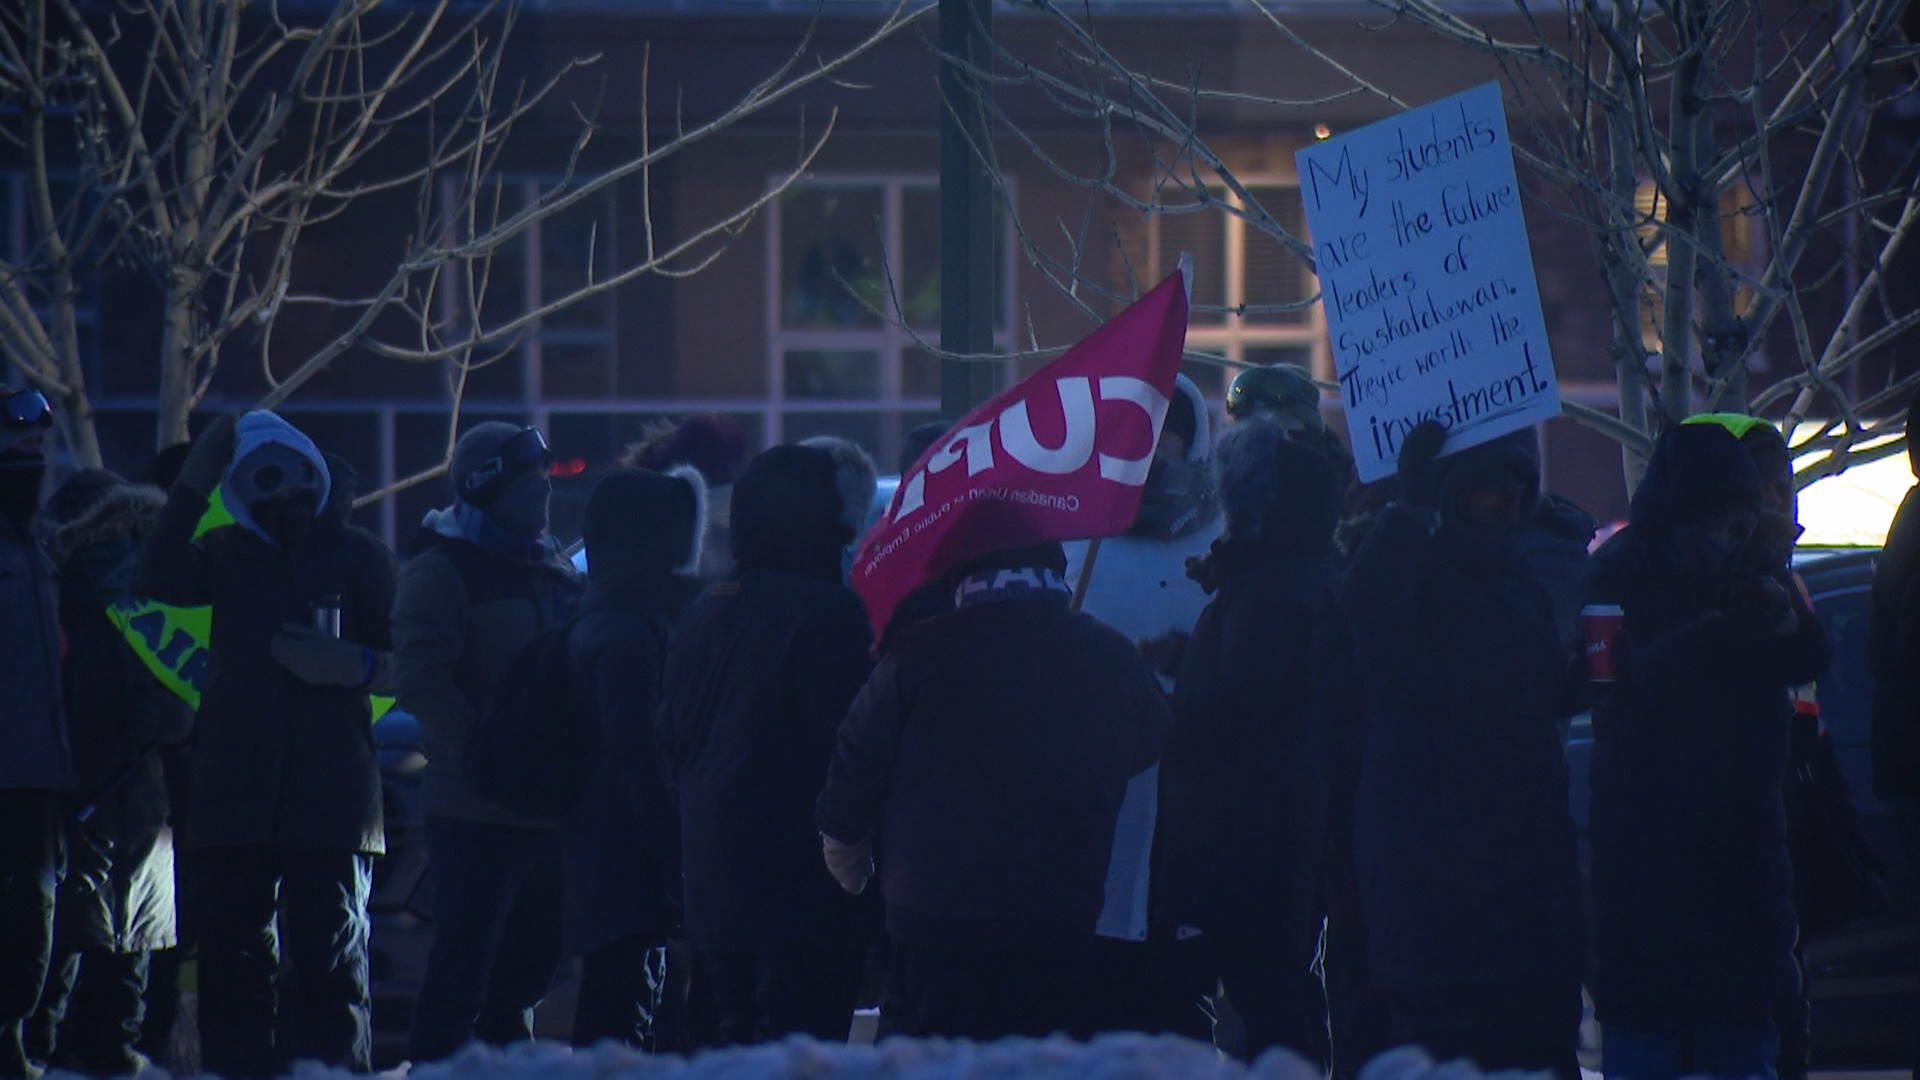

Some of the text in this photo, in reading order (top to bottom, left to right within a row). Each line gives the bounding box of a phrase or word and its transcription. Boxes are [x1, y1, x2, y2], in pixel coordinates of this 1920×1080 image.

[1307, 101, 1496, 219] My students
[1319, 180, 1511, 274] are the future
[1331, 233, 1472, 323] leaders of
[1339, 277, 1517, 366] Saskatchewan.
[1415, 327, 1474, 376] worth
[1489, 311, 1526, 348] the
